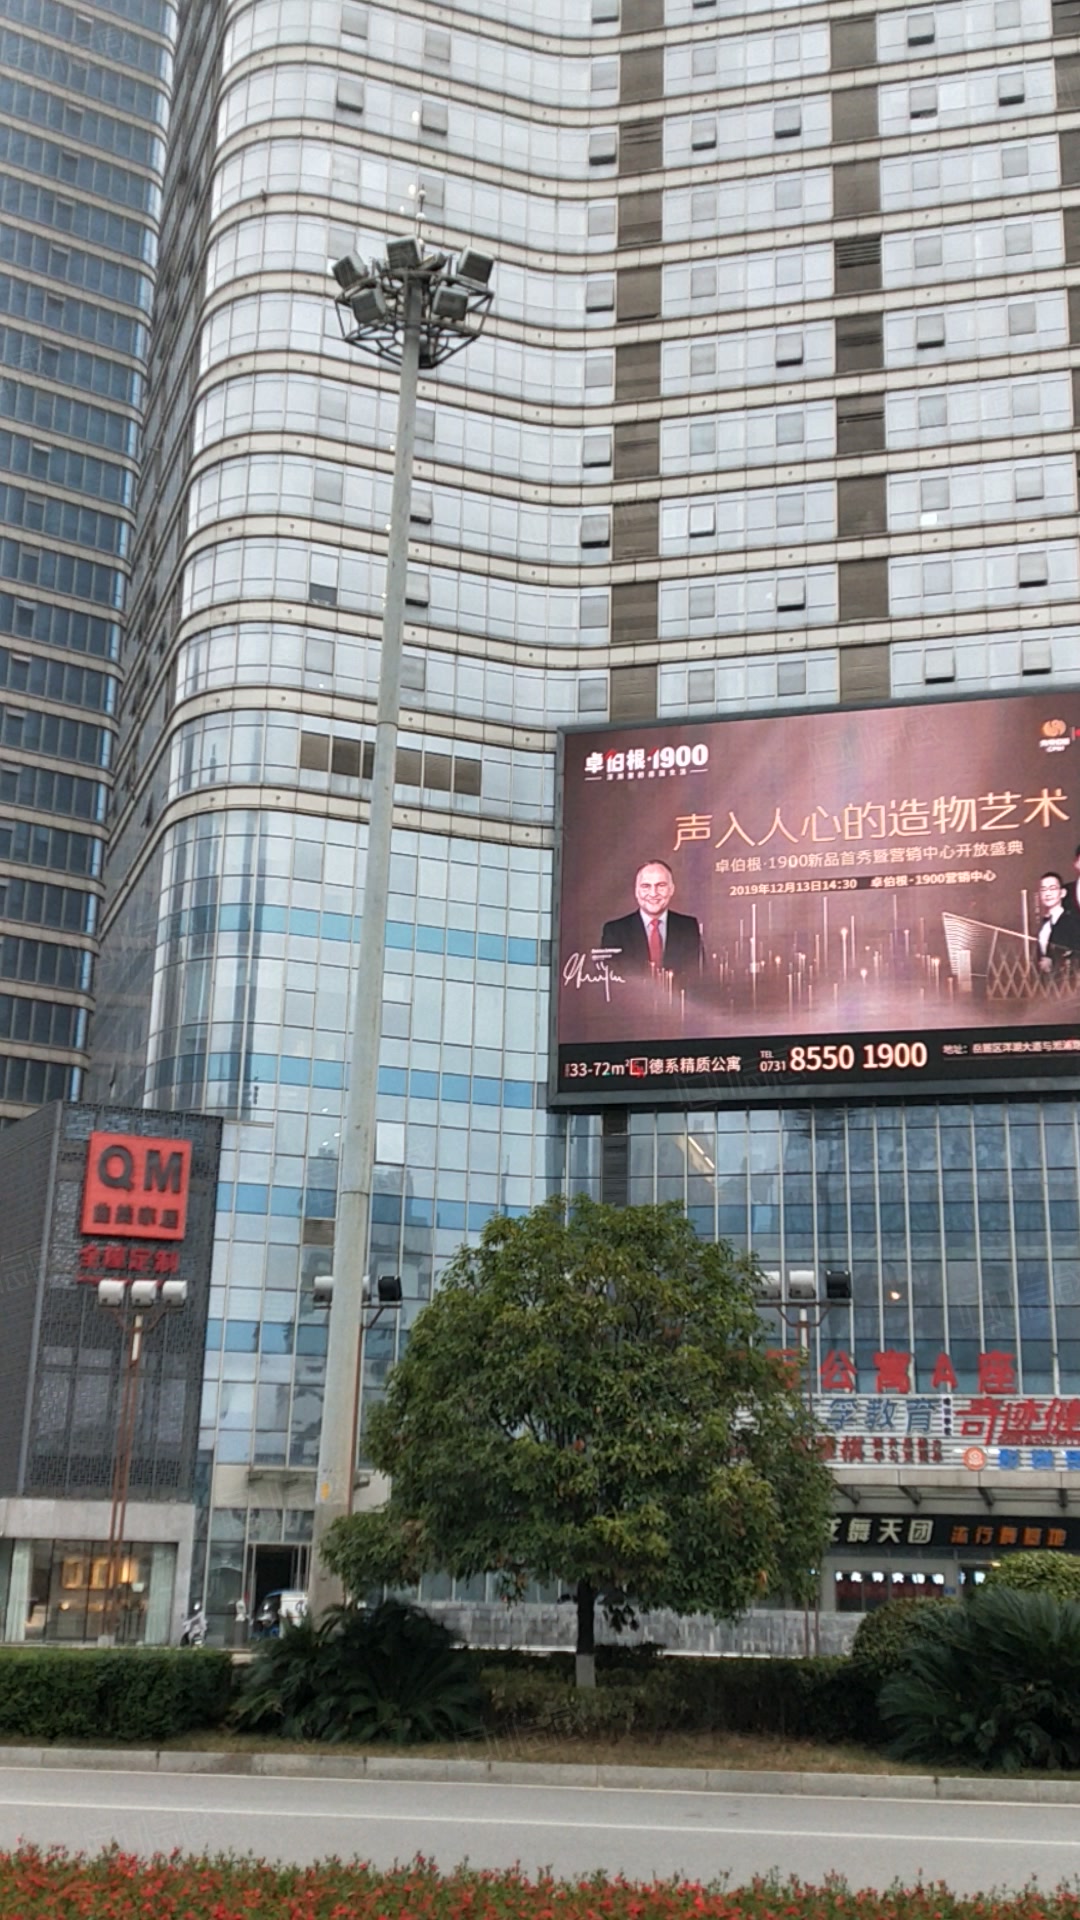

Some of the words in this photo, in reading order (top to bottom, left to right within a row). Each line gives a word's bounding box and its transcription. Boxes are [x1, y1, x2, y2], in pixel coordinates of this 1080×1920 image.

[673, 788, 1070, 851] 声入人心的造物艺术
[649, 1056, 742, 1075] 德系精质公寓
[760, 1060, 786, 1072] 0731
[790, 1045, 855, 1072] 8550
[863, 1041, 928, 1069] 1900
[98, 1144, 184, 1194] QM
